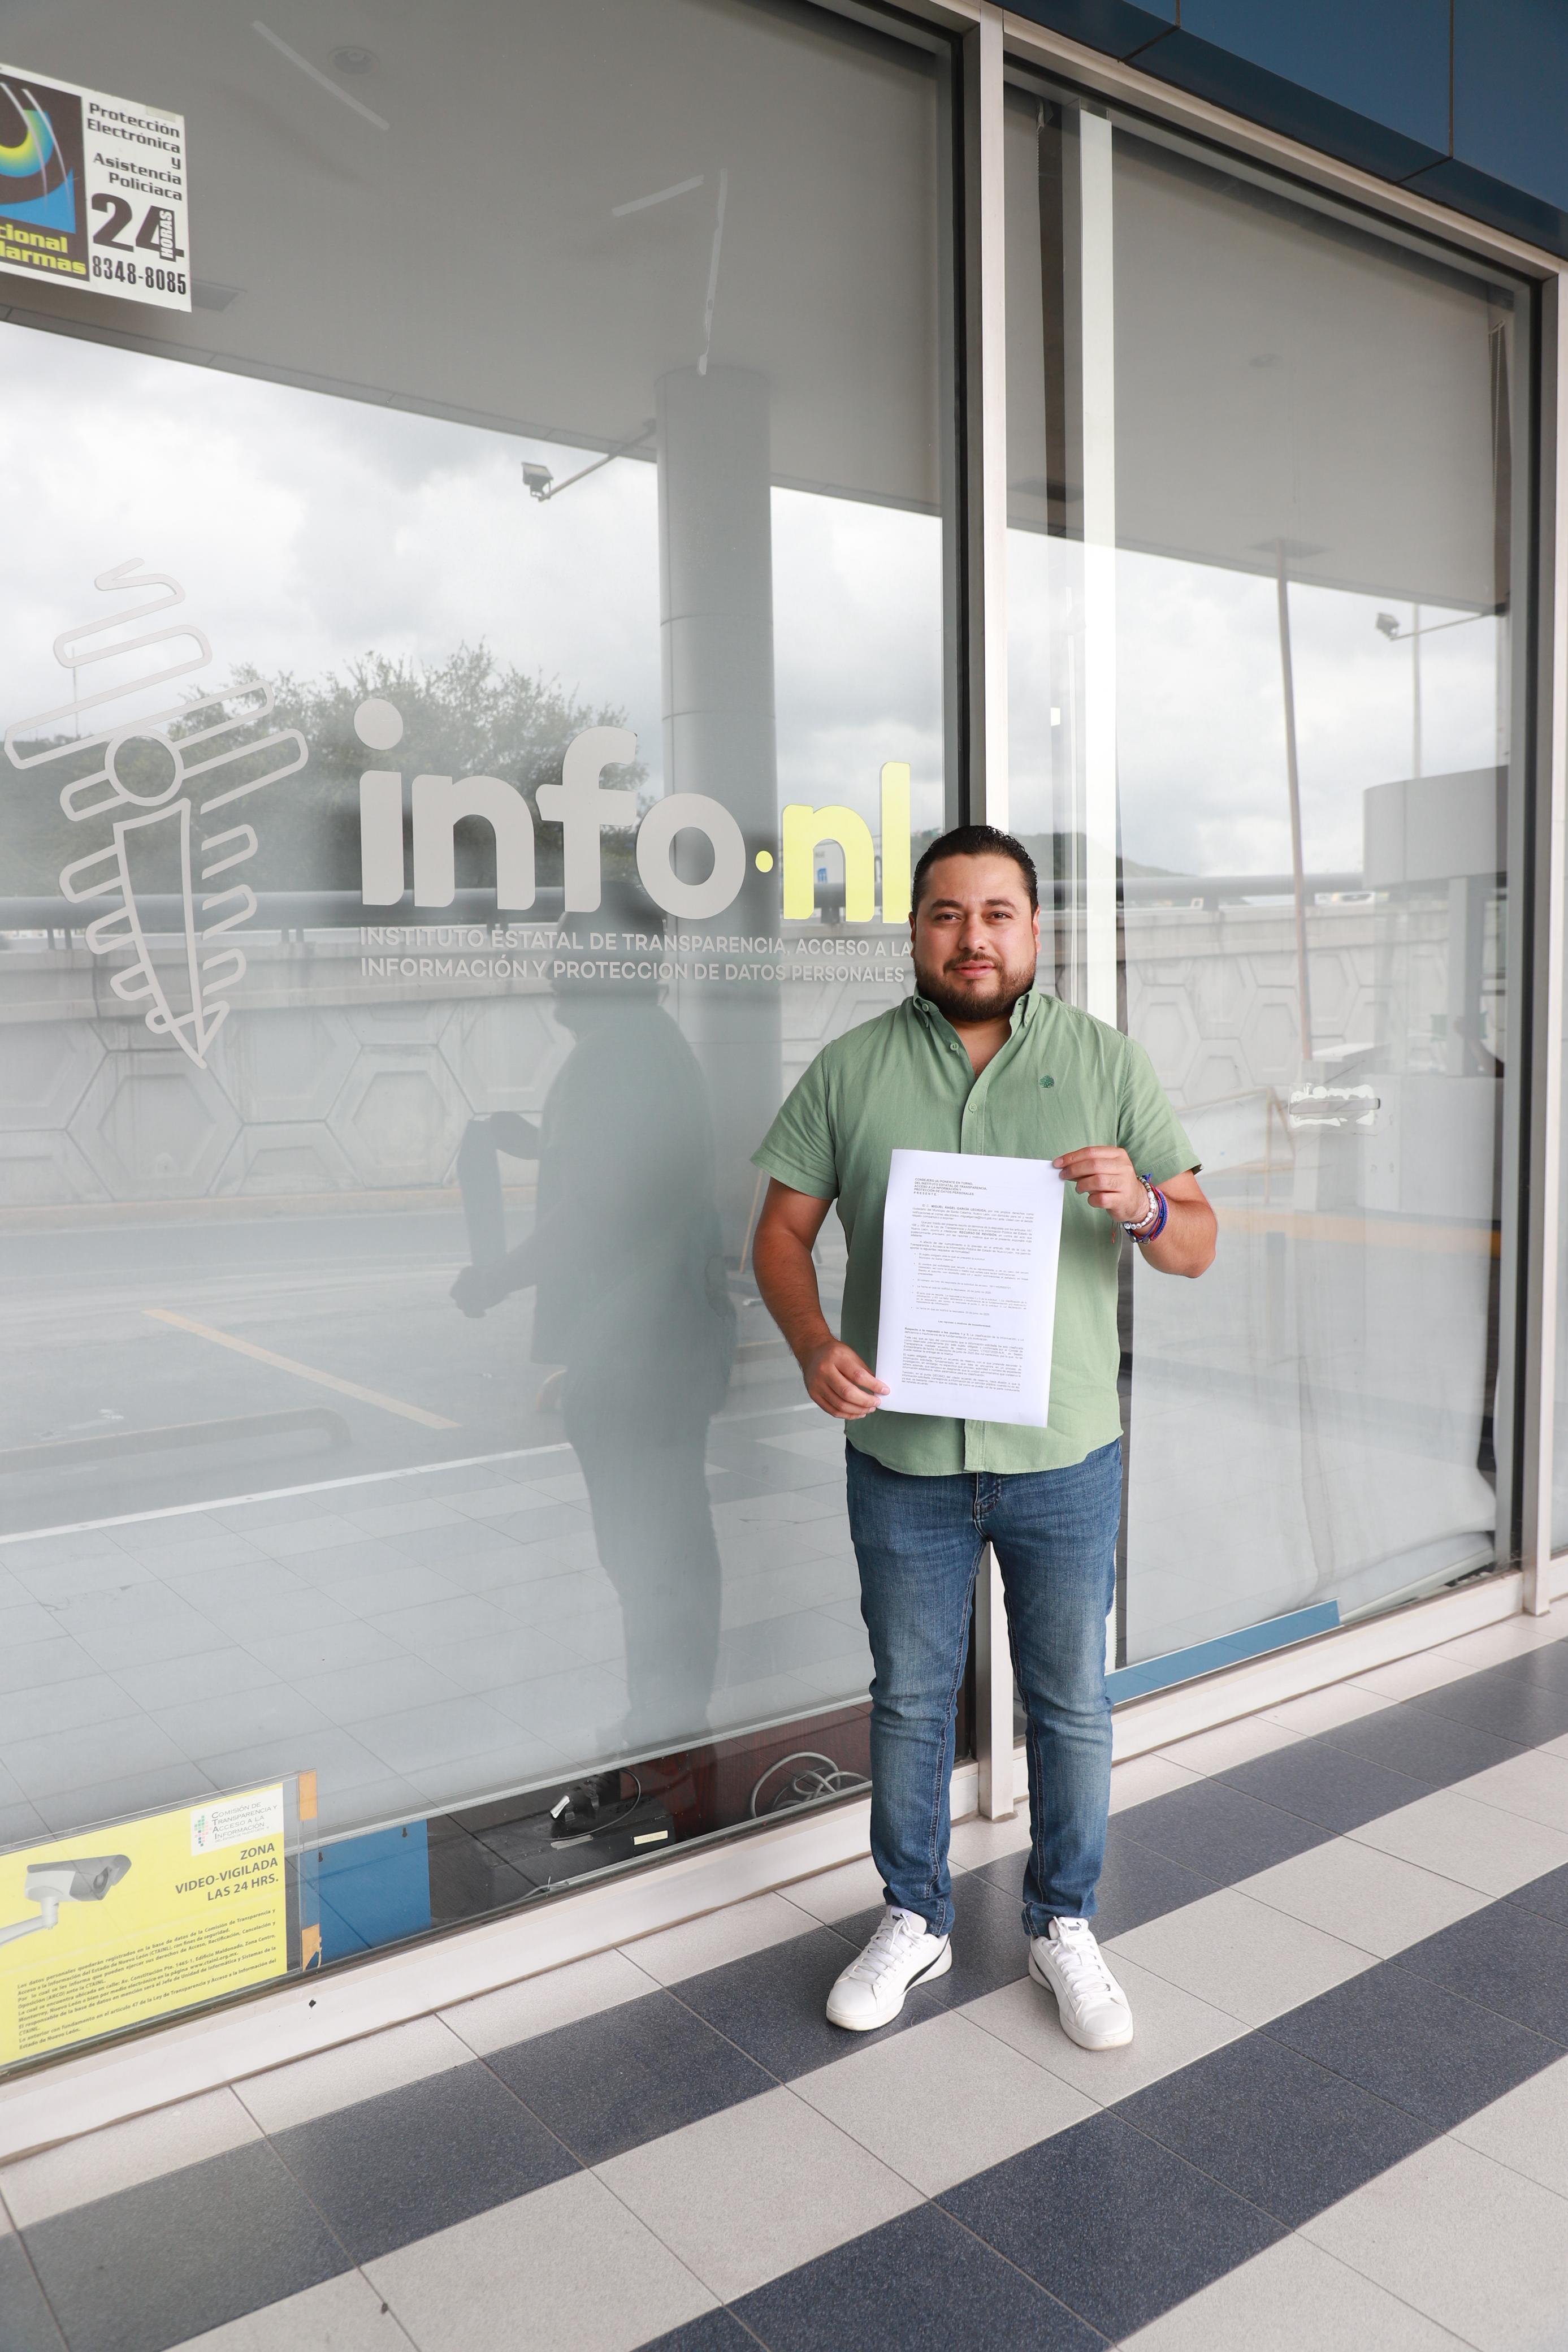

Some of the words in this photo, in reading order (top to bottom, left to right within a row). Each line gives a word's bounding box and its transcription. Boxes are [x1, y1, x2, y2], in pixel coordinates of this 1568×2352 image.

[89, 102, 180, 138] Protección
[87, 118, 180, 154] Electrónica
[93, 153, 182, 185] Asistencia
[171, 157, 181, 170] y
[109, 172, 183, 201] Policiaca
[92, 193, 184, 259] 24
[159, 210, 174, 259] HORAS
[92, 255, 186, 295] 8348-8085
[360, 926, 484, 948] INSTITUTO
[491, 929, 584, 950] ESTATAL
[590, 932, 617, 950] DE
[622, 933, 790, 957] TRANSPARENCIA,
[795, 938, 869, 957] ACCESO
[874, 941, 886, 957] A
[891, 941, 911, 957] LA
[361, 954, 527, 978] INFORMACIÓN
[534, 960, 547, 978] Y
[553, 961, 688, 980] PROTECCION
[694, 963, 720, 980] DE
[725, 964, 785, 982] DATOS
[792, 965, 904, 983] PERSONALES
[211, 1805, 249, 1818] COMISIÓN
[212, 1807, 271, 1826] TRANSPARENCIA
[213, 1820, 245, 1833] ACCESO
[240, 1843, 275, 1860] ZONA
[175, 1857, 278, 1894] VIDEO-VIGILADA
[207, 1886, 231, 1901] LAS
[233, 1882, 248, 1893] 24
[251, 1873, 279, 1888] HRS.
